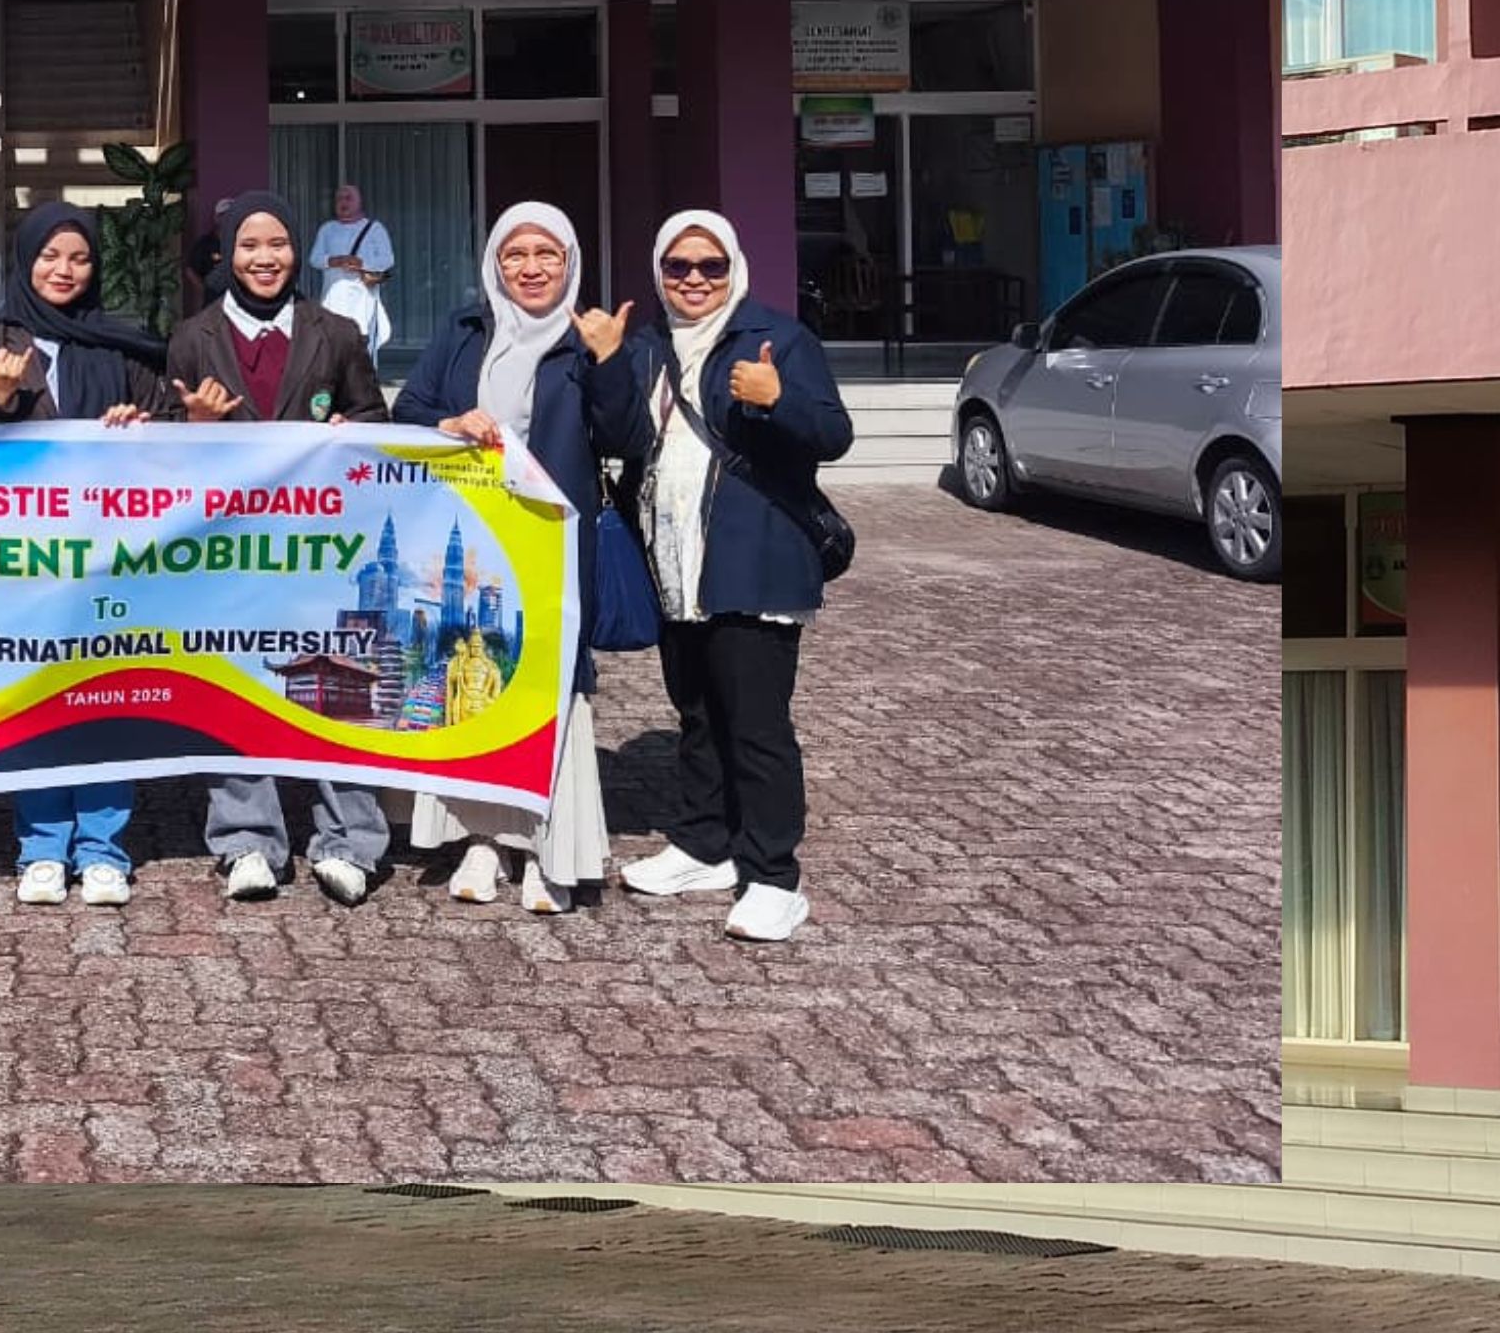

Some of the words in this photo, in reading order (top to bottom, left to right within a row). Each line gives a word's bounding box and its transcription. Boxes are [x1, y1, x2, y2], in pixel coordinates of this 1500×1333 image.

[377, 461, 428, 485] INTI
[83, 487, 192, 518] “KBP”
[205, 487, 342, 518] PADANG
[112, 534, 365, 576] MOBILITY
[94, 596, 127, 620] To
[183, 631, 373, 655] UNIVERSITY
[65, 689, 125, 706] TAHUN
[131, 688, 171, 702] 2026
